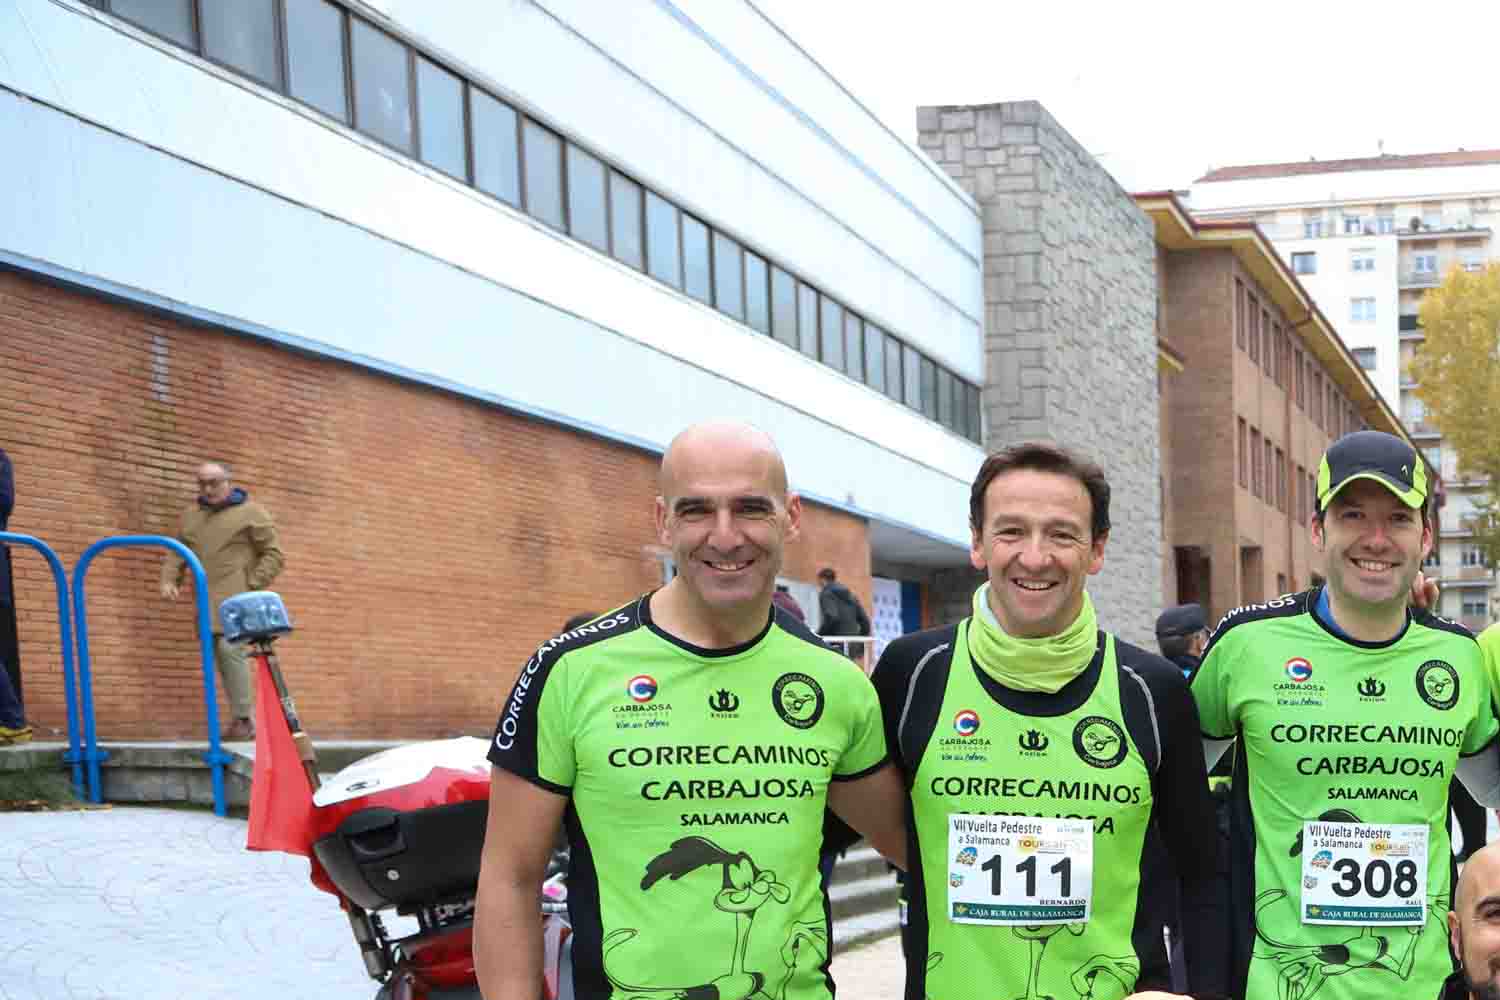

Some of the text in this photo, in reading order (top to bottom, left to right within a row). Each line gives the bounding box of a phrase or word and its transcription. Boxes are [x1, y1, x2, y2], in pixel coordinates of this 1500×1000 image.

[495, 612, 630, 751] CORRECAMINOS
[612, 703, 673, 713] CARBAJOSA
[1270, 724, 1463, 748] CORRECAMINOS
[608, 744, 830, 768] CORRECAMINOS
[1296, 757, 1444, 778] CARBAJOSA
[640, 778, 815, 801] CARBAJOSA
[931, 777, 1141, 805] CORRECAMINOS
[1327, 787, 1419, 801] SALAMANCA
[680, 811, 789, 827] SALAMANCA
[953, 819, 967, 831] VII
[968, 820, 997, 833] Vuelta
[1000, 821, 1042, 834] Pedestre
[1310, 825, 1391, 838] VII Vuelta Pedestre
[966, 835, 1010, 847] Salamanca
[1320, 839, 1363, 848] Salamanca
[981, 854, 1071, 898] 111
[1331, 858, 1418, 898] 308
[1040, 898, 1086, 906] BERNARDO
[969, 908, 989, 917] CAJA
[991, 909, 1017, 917] RURAL
[1031, 909, 1085, 918] SALAMANCA
[1380, 911, 1421, 919] SALAMANCA
